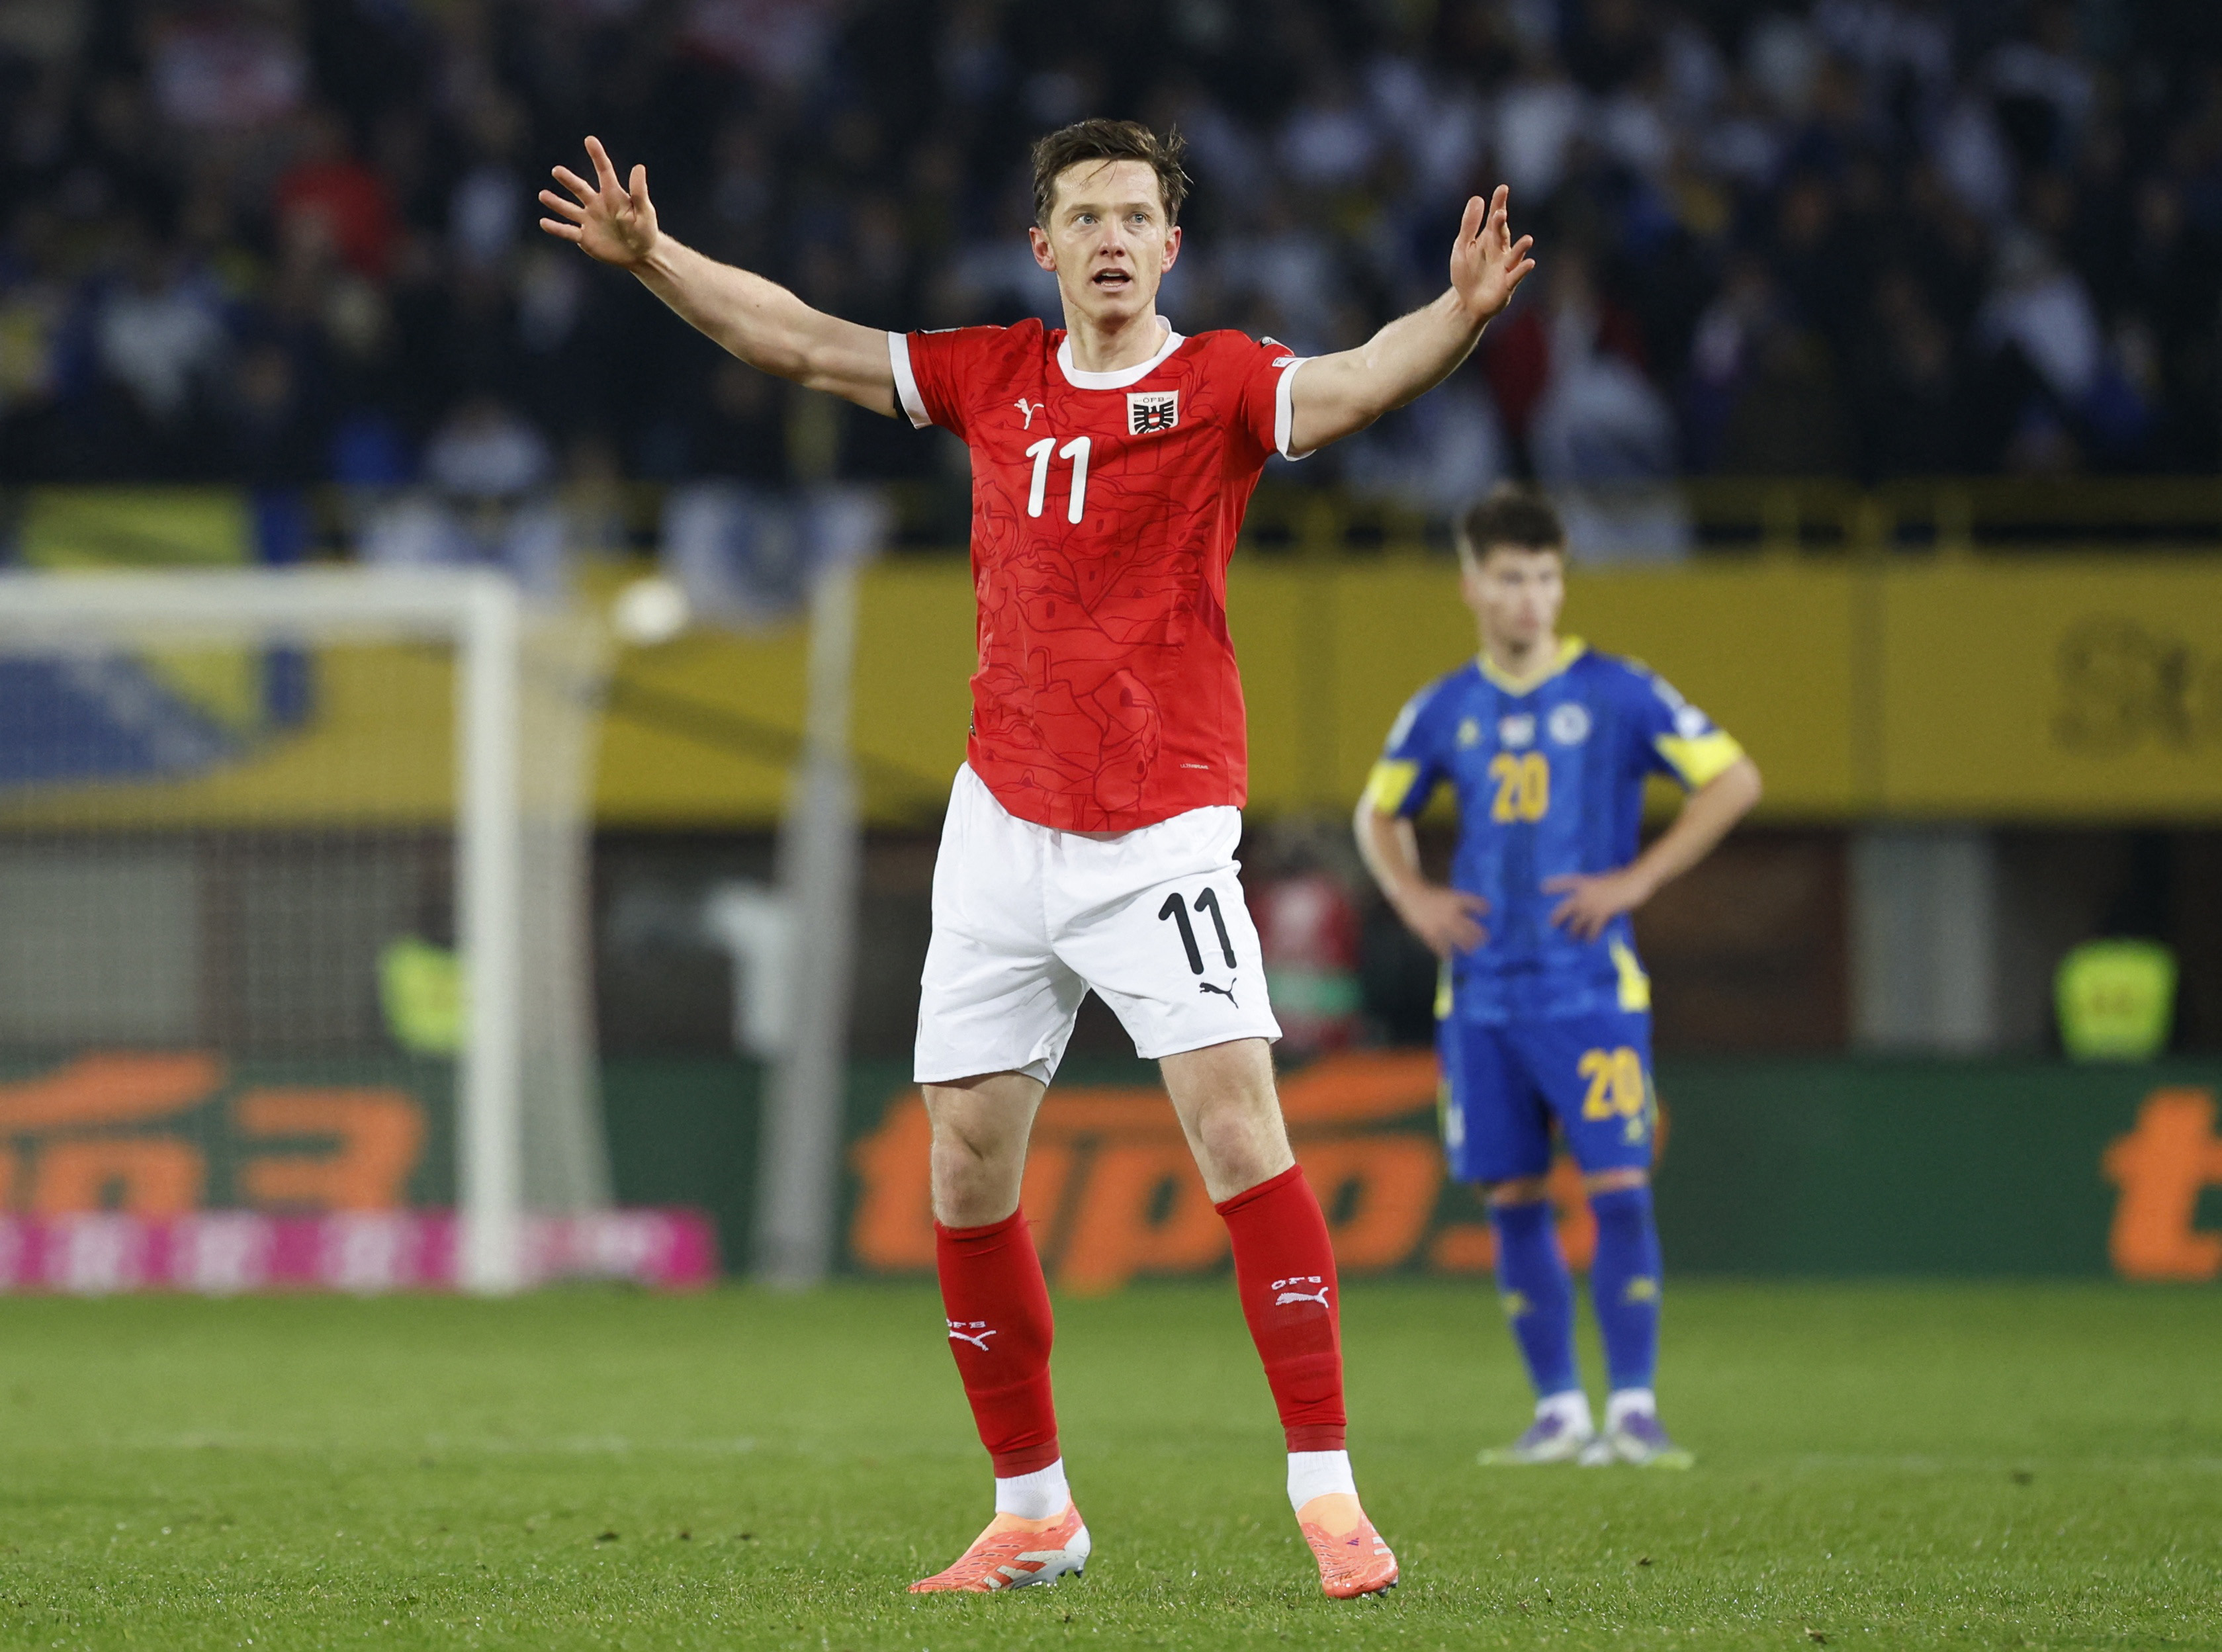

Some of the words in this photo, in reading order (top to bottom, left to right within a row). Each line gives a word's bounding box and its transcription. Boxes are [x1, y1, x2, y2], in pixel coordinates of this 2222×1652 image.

[1026, 435, 1091, 524] 11
[1489, 751, 1550, 822] 20
[1158, 887, 1237, 975] 11
[1578, 1046, 1645, 1120] 20
